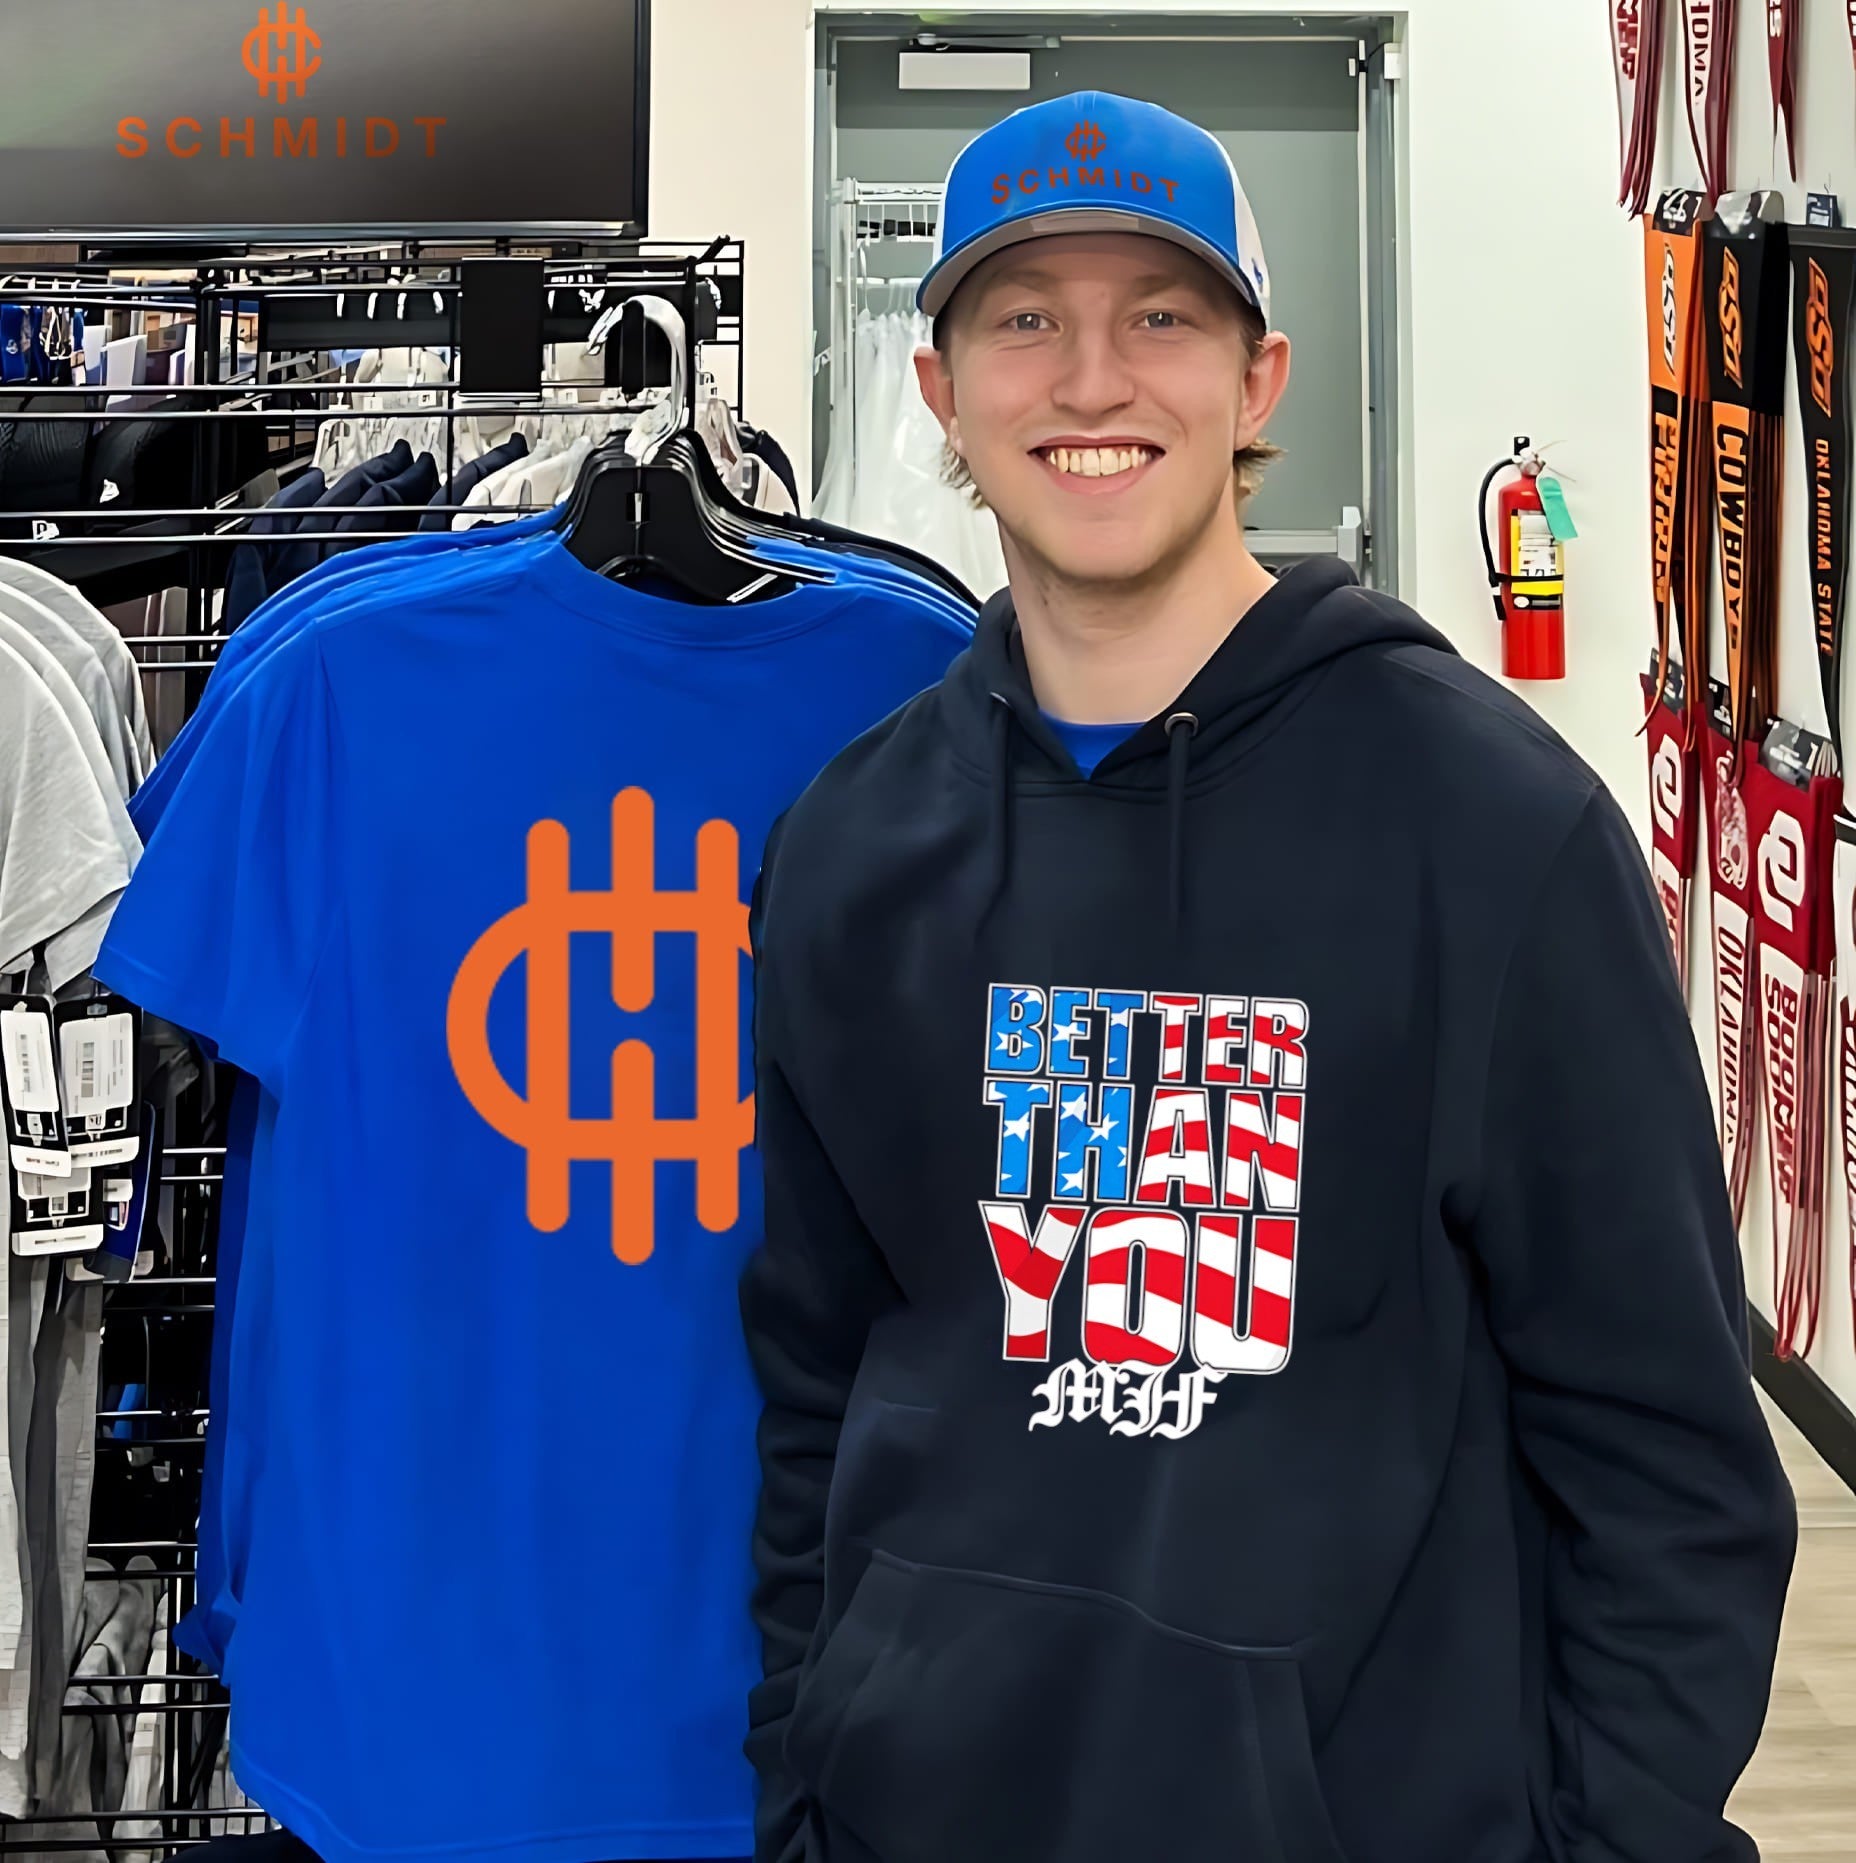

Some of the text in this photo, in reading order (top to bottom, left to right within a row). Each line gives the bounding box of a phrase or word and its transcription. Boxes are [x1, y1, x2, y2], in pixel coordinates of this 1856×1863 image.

[115, 116, 448, 159] SCHMIDT
[990, 166, 1180, 205] SCHMIDT
[1815, 438, 1832, 570] OKLAHOMA
[984, 982, 1309, 1090] BETTER
[982, 1076, 1306, 1212] THAN
[978, 1200, 1299, 1374] YOU
